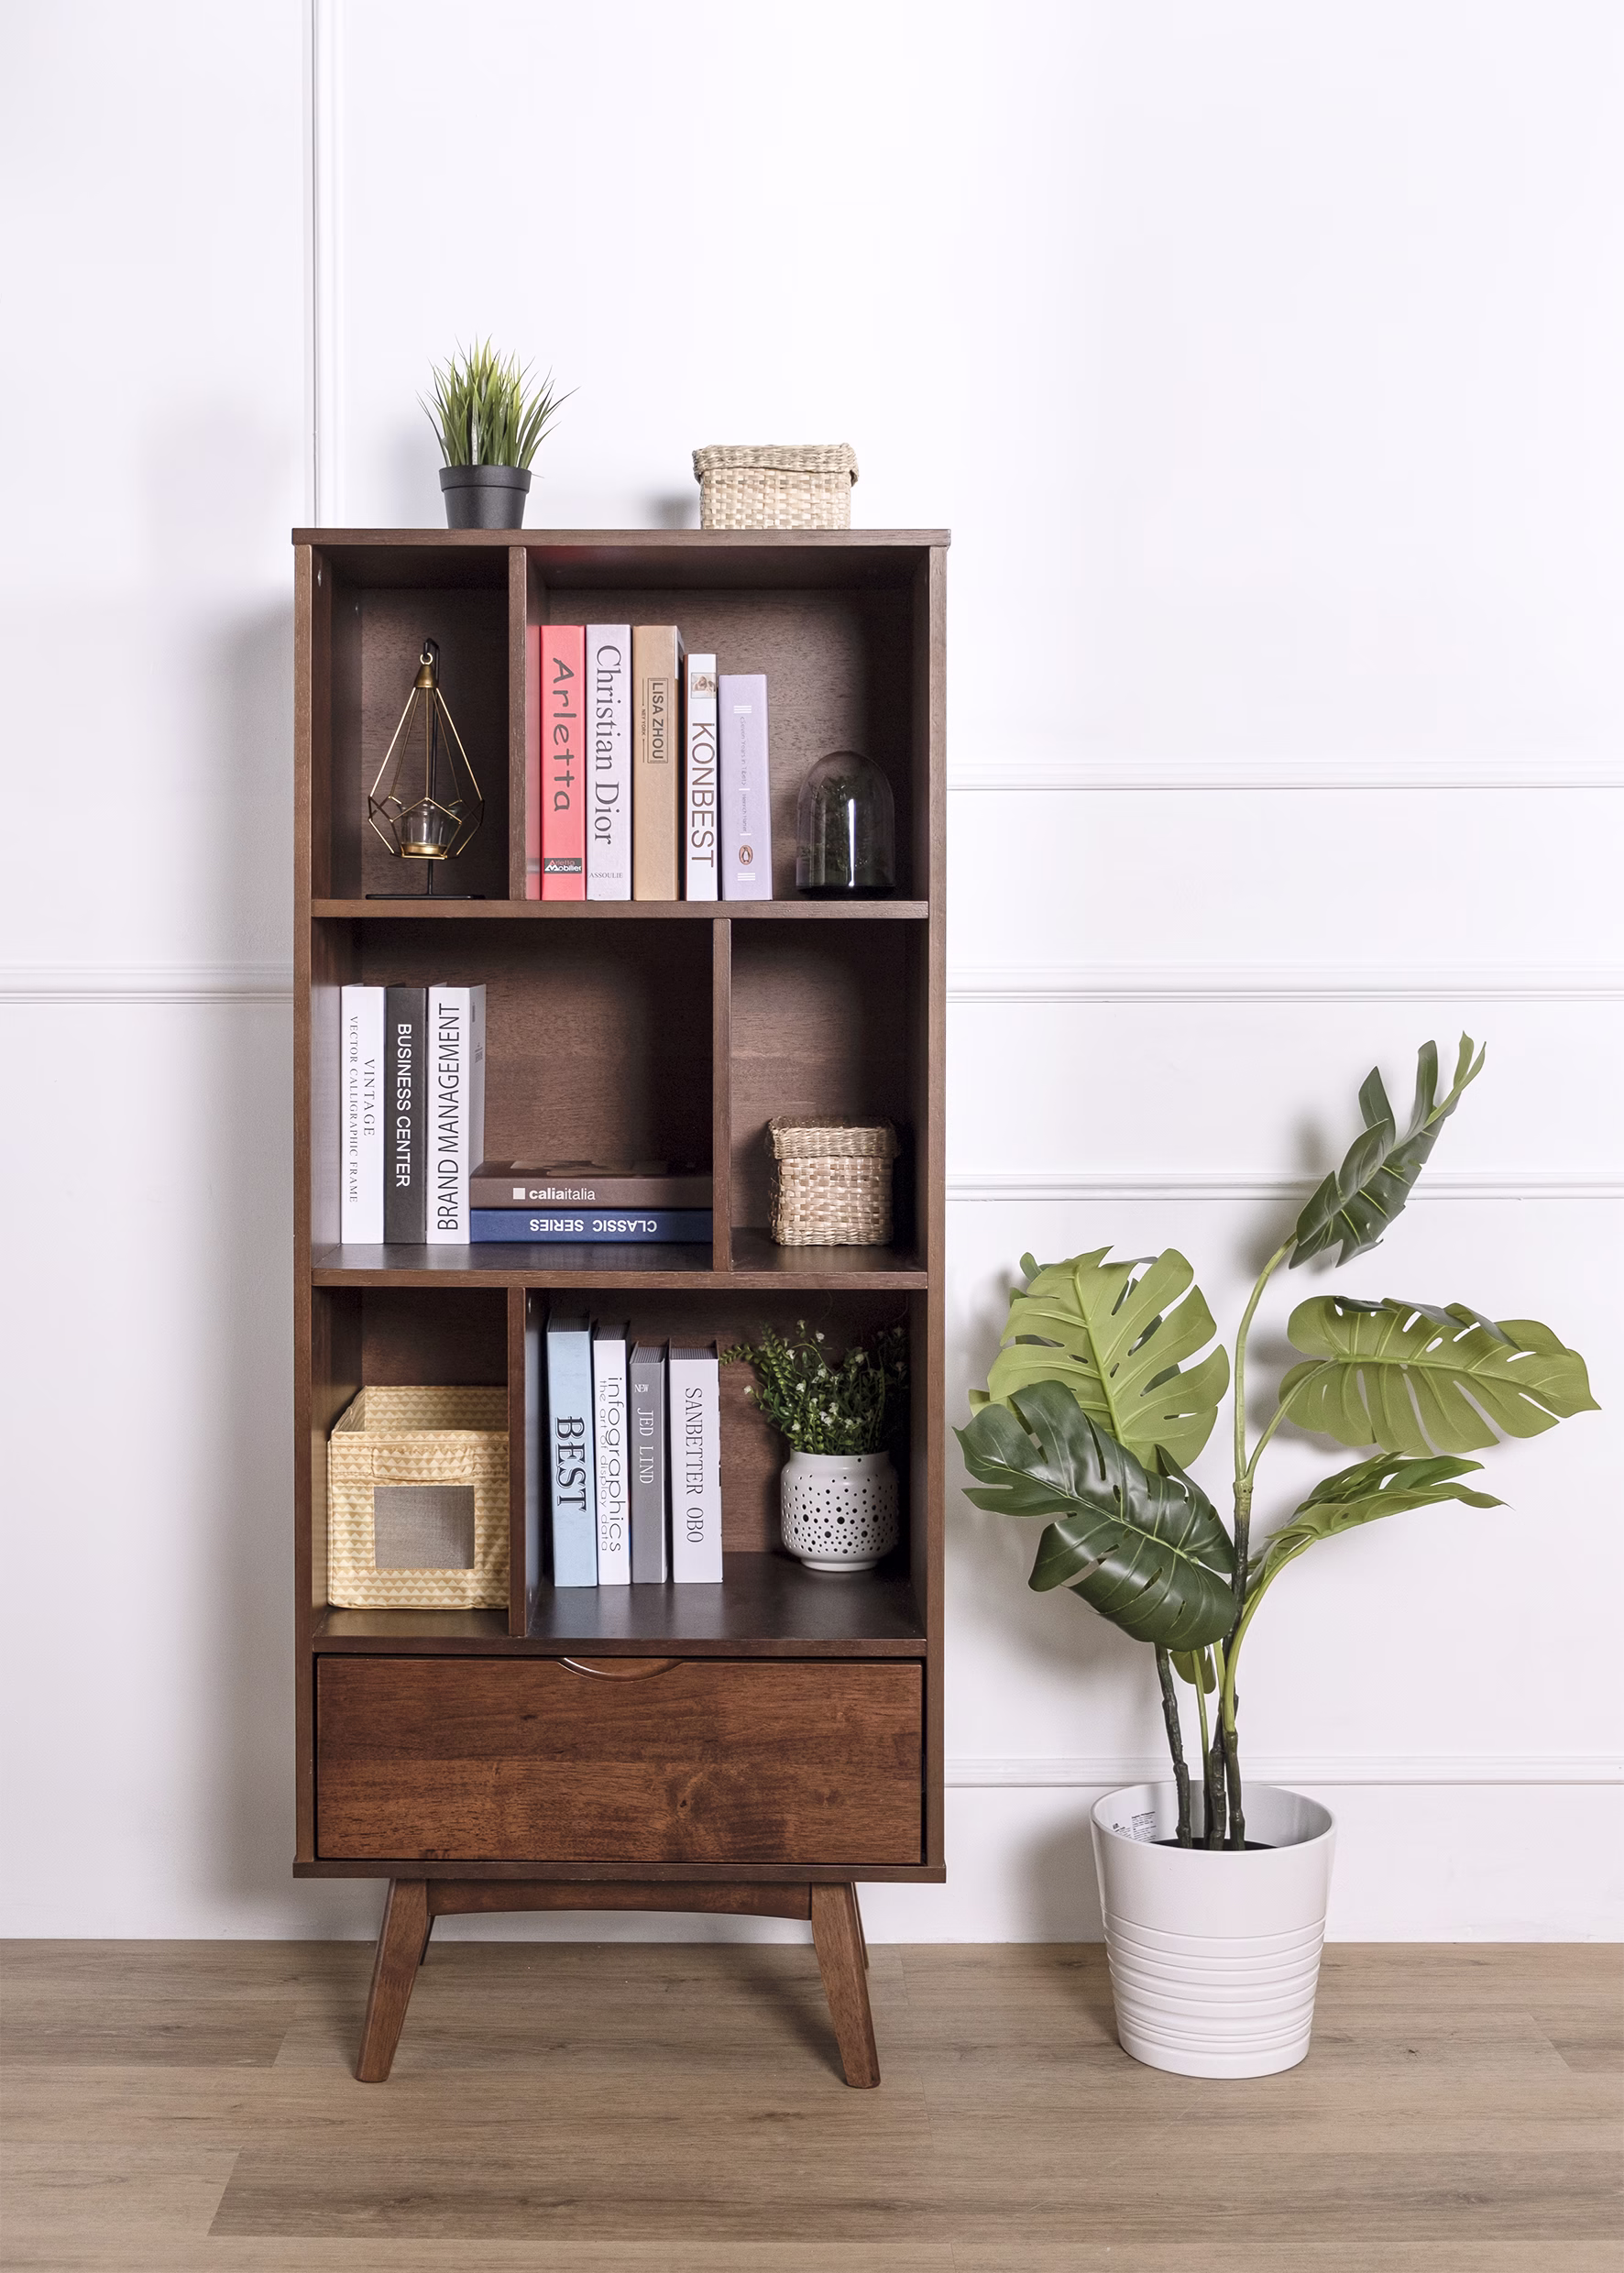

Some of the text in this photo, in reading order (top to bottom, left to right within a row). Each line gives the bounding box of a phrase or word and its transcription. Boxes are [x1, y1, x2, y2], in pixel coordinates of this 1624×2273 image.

[553, 657, 576, 811] Arletta
[595, 645, 621, 845] Christian Dior
[653, 682, 664, 759] LISA ZHOU
[691, 723, 715, 868] KONBEST
[349, 1016, 358, 1202] VECTOR CALLIGRAPHIC FRAME
[364, 1059, 375, 1136] VINTAGE
[396, 1024, 412, 1187] BUSINESS CENTER
[438, 1003, 460, 1230] BRAND MANAGEMENT
[529, 1188, 596, 1201] caliaitalia
[529, 1219, 657, 1232] CLASSIC SERIES
[634, 1384, 650, 1393] NEW
[636, 1408, 654, 1484] JED LIND
[554, 1415, 587, 1512] BEST
[599, 1380, 609, 1551] the art of display data
[606, 1377, 626, 1553] infographics
[685, 1388, 704, 1543] SANBETTER OBO
